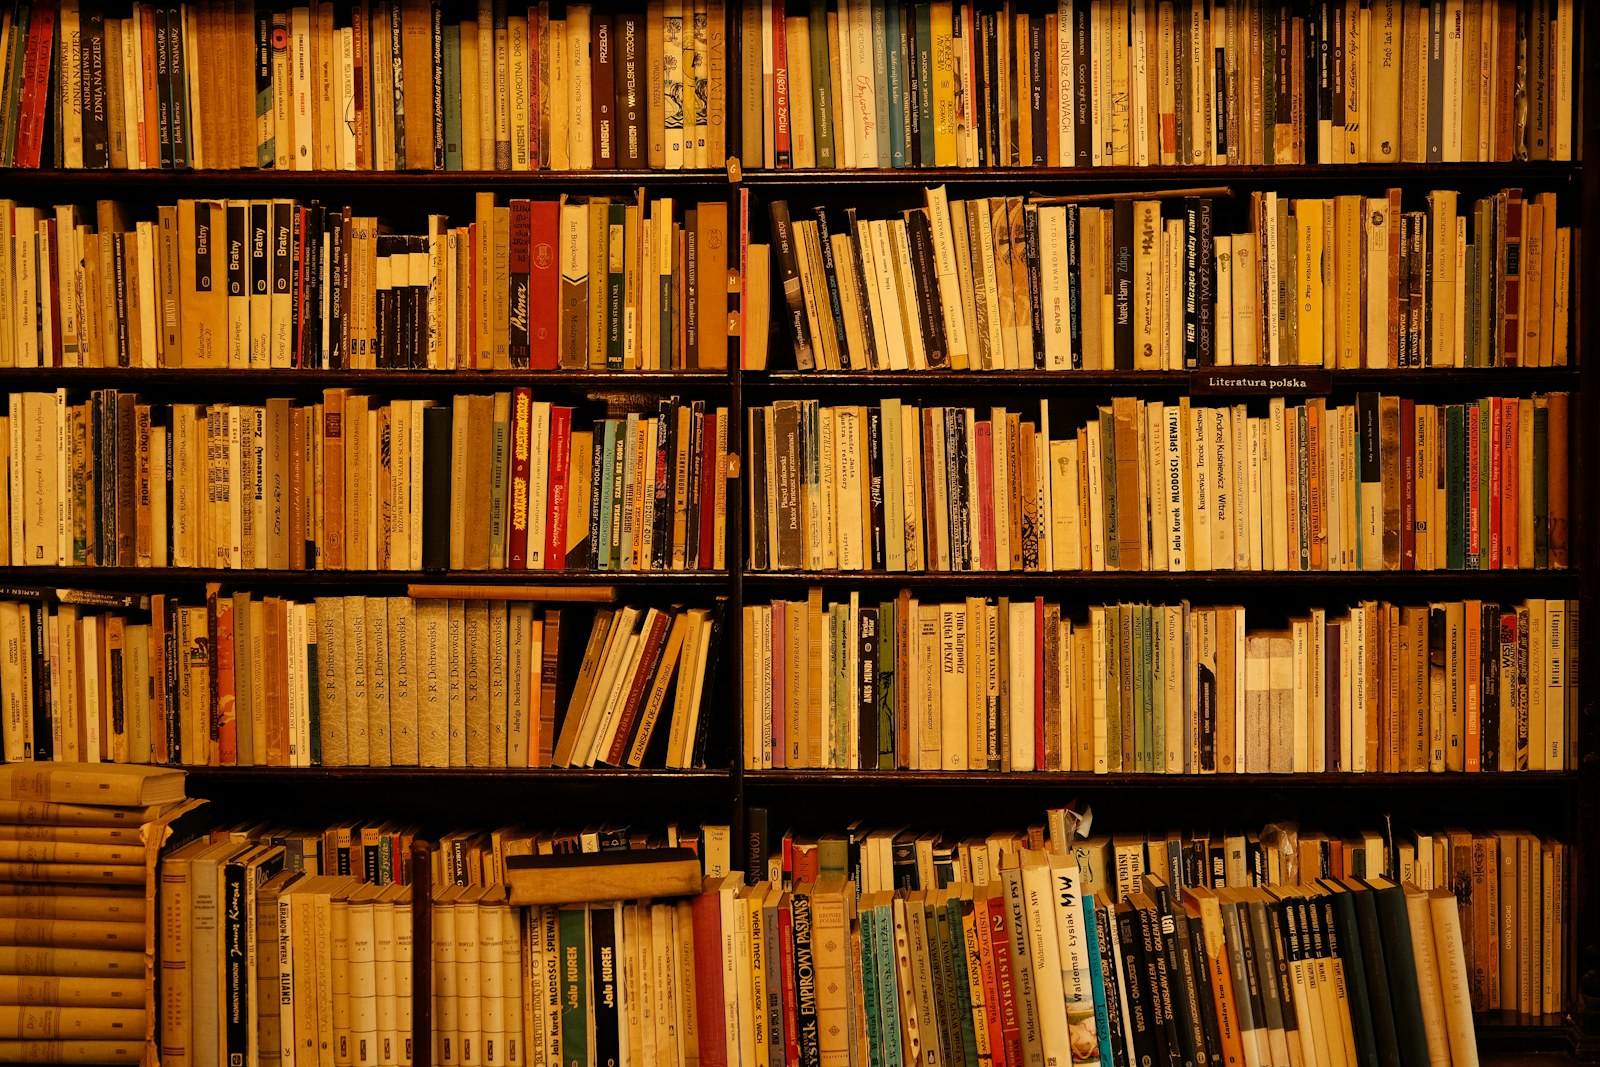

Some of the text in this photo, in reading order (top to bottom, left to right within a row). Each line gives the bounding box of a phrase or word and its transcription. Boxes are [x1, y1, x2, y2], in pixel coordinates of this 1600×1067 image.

[38, 40, 49, 84] APELACJA
[70, 31, 80, 62] DZIEŃ
[90, 37, 101, 67] DZIEŃ
[1536, 33, 1545, 79] opowiadania
[62, 41, 70, 104] ANDRZEJEWSKI
[72, 64, 80, 80] NA
[82, 48, 91, 111] ANDRZEJEWSKI
[93, 70, 102, 87] NA
[624, 20, 637, 158] BUNSCH WAWELSKIE WZGÓRZE
[711, 32, 722, 125] OLIMPIAS
[776, 68, 785, 94] Nigdy
[1536, 82, 1545, 100] hołuj
[73, 82, 81, 106] DNIA
[93, 89, 103, 113] DNIA
[513, 26, 525, 164] BUNSCH POWROTNA DROGA
[160, 102, 170, 144] Jędrek Barwicz
[778, 107, 787, 133] Życiu!
[730, 164, 736, 173] G
[198, 224, 209, 255] Bratny
[230, 240, 241, 270] Bratny
[254, 228, 265, 258] Bratny
[277, 226, 289, 256] Bratny
[332, 246, 341, 265] Bratny
[570, 234, 579, 271] Brzękowski
[778, 221, 789, 253] JÓZEF HEN
[1187, 236, 1198, 268] między
[496, 243, 506, 281] NURT
[729, 276, 736, 285] H
[1117, 246, 1131, 325] Marek Harny Zdrajca
[1187, 271, 1197, 313] Milczące
[794, 310, 806, 350] Pingpongista
[1187, 323, 1195, 342] HEN
[1209, 377, 1307, 388] Literatura polska
[140, 413, 148, 452] OKOPÓW
[787, 432, 797, 471] przemianach
[255, 410, 264, 500] Białoszewski Zawał
[729, 460, 736, 471] K
[1195, 410, 1205, 510] Kuśniewicz Trzecie królestwo
[1215, 413, 1226, 521] Andrzej Kuśniewicz Witraż
[781, 489, 789, 508] Placyd
[1168, 412, 1181, 552] Jalu Kurek MŁODOŚCI, ŚPIEWAJ!
[592, 487, 600, 519] JESTEŚMY
[789, 508, 797, 529] Doktor
[325, 619, 334, 677] Dobrowolski
[763, 613, 771, 652] przeźrocza
[943, 612, 953, 674] KSIĘGA PUSZCZY
[955, 612, 966, 674] Tytus Karpowicz
[181, 610, 190, 697] Dankowski Jeniec Europy
[1356, 645, 1364, 676] Mieszaniny
[327, 680, 335, 689] R.
[863, 660, 873, 703] ANUS MUNDI
[633, 664, 671, 761] STANISŁAW DEJCZER Strach
[1519, 684, 1528, 738] KRZYSZTON
[229, 881, 242, 957] Janusz Korczak
[979, 910, 989, 957] SZACHISTA
[1058, 876, 1080, 1002] Waldemar Łysiak MW
[1139, 910, 1153, 952] GOLEM XIV
[567, 946, 578, 1008] Jalu KUREK
[601, 946, 613, 1008] Jalu KUREK
[794, 900, 813, 1015] EMPIROWY PASJANS
[965, 927, 979, 986] KONKWISTA
[992, 915, 1015, 1026] KONKWISTA 2
[1009, 880, 1035, 1042] Waldemar Łysiak MILCZĄCE PSY
[231, 962, 240, 1023] FRAGMENTY UTWORÓW
[548, 956, 558, 1005] MŁODOŚCI,
[1148, 963, 1163, 1025] STANISŁAW LEM
[550, 1011, 558, 1036] Kurek
[551, 1040, 559, 1056] Jalu
